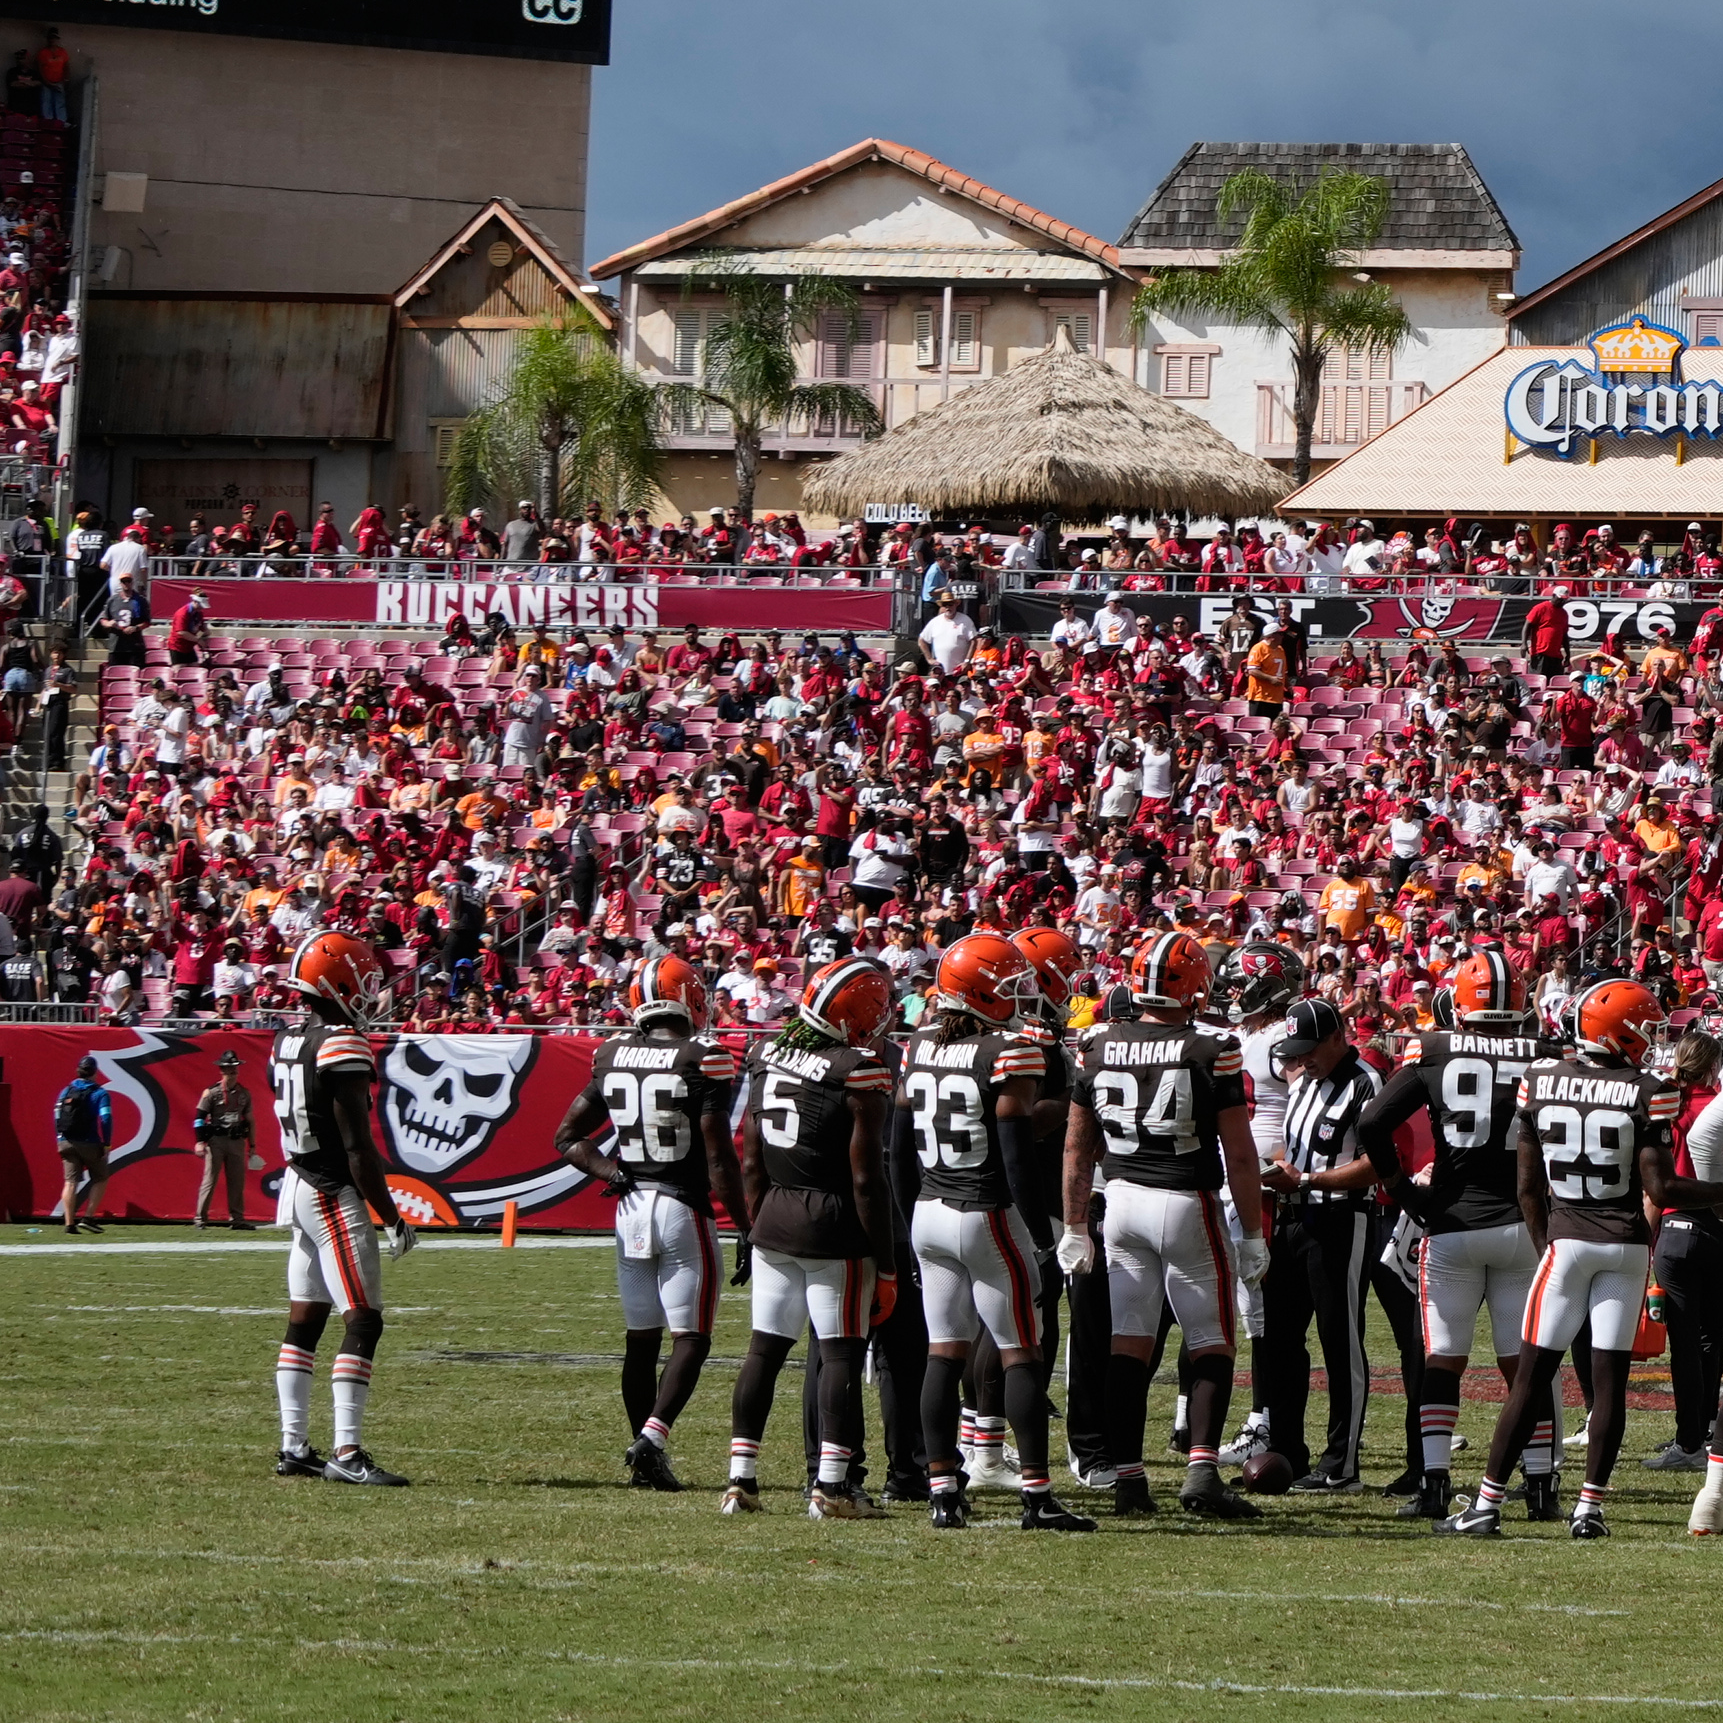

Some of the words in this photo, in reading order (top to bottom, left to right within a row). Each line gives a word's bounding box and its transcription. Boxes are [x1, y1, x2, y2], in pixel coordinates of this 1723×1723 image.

[865, 503, 897, 522] COLD
[898, 503, 932, 522] BEER
[376, 581, 659, 628] BUCCANEERS
[119, 609, 131, 626] 3
[1230, 631, 1252, 652] 17
[1274, 658, 1284, 677] 7
[668, 861, 692, 882] 73
[1330, 890, 1358, 910] 55
[808, 937, 836, 963] 95
[1138, 996, 1166, 1006] CLEVELAND
[1483, 1012, 1514, 1020] CLEVELAND
[1103, 1040, 1185, 1067] GRAHAM
[1448, 1033, 1538, 1057] BARNETT
[612, 1047, 679, 1070] HARDEN
[1534, 1075, 1640, 1107] BLACKMON
[273, 1063, 321, 1155] 21
[602, 1073, 691, 1163] 26
[754, 1066, 801, 1150] 5
[905, 1071, 989, 1170] 33
[1092, 1068, 1202, 1157] 94
[1537, 1105, 1635, 1200] 29
